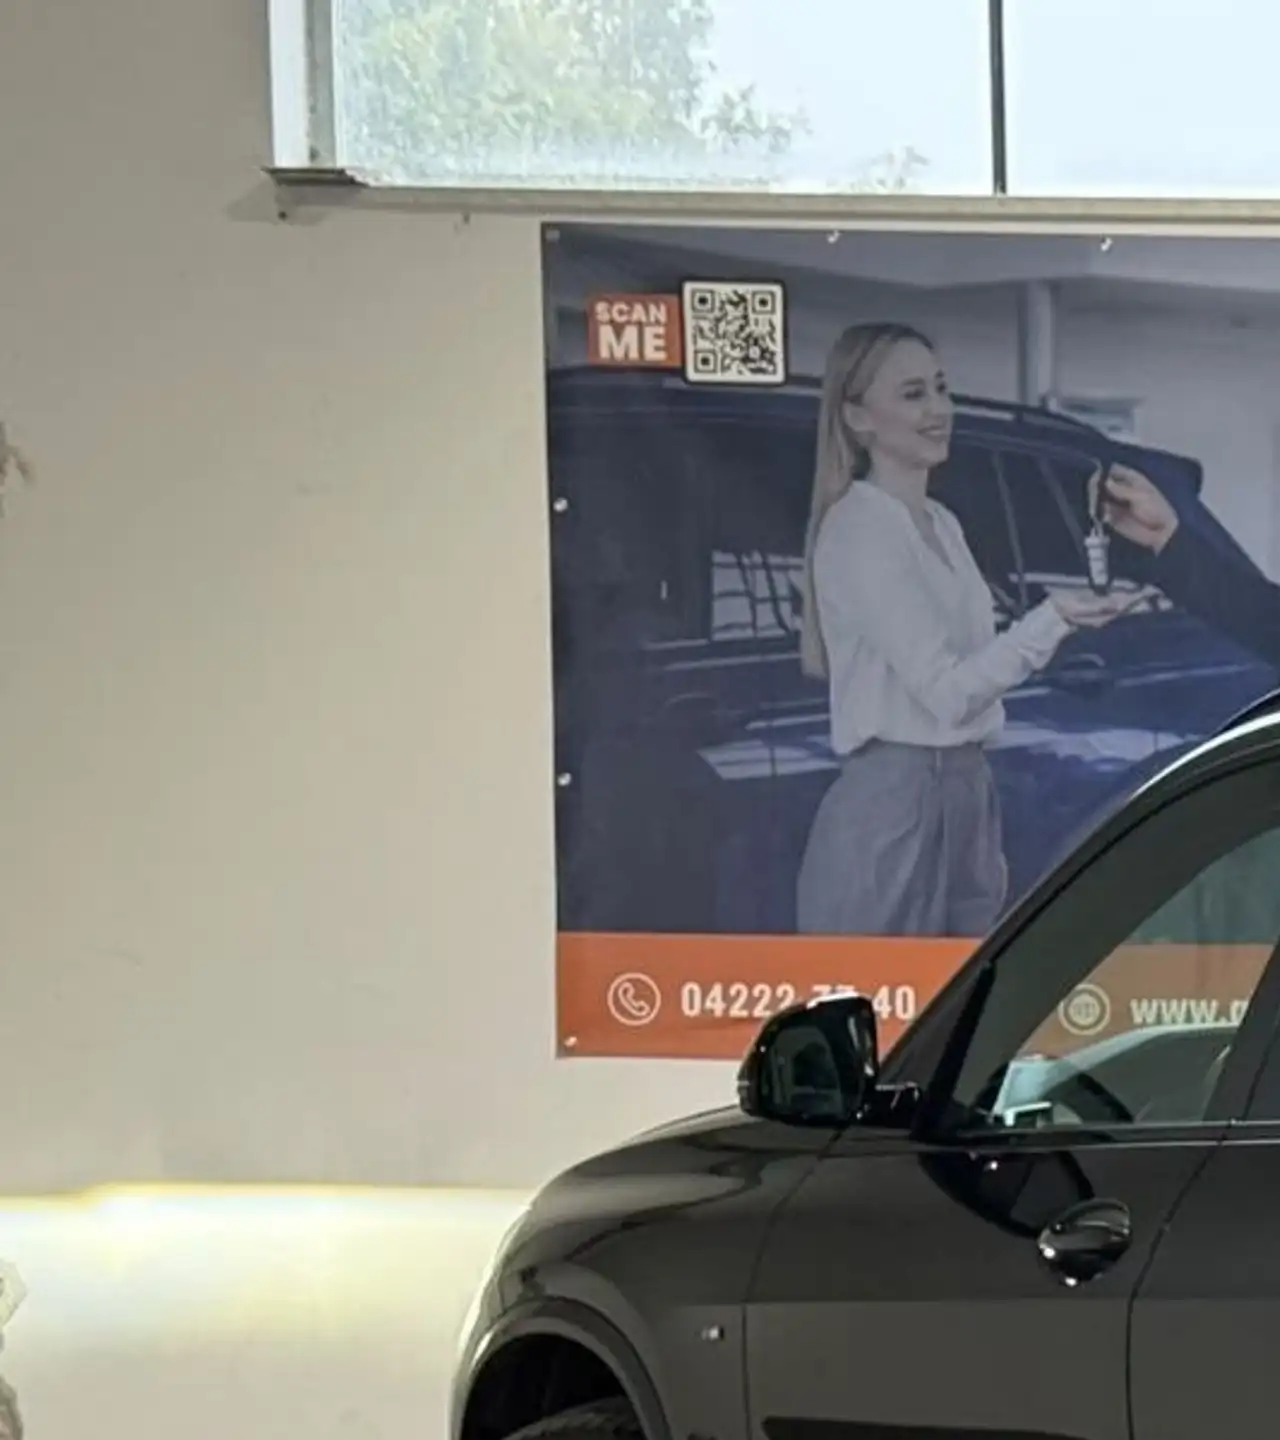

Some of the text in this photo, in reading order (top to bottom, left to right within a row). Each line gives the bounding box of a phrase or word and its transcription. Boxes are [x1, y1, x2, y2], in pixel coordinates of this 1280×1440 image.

[594, 300, 669, 325] SCAN
[598, 326, 668, 362] ME
[680, 981, 796, 1018] 04222
